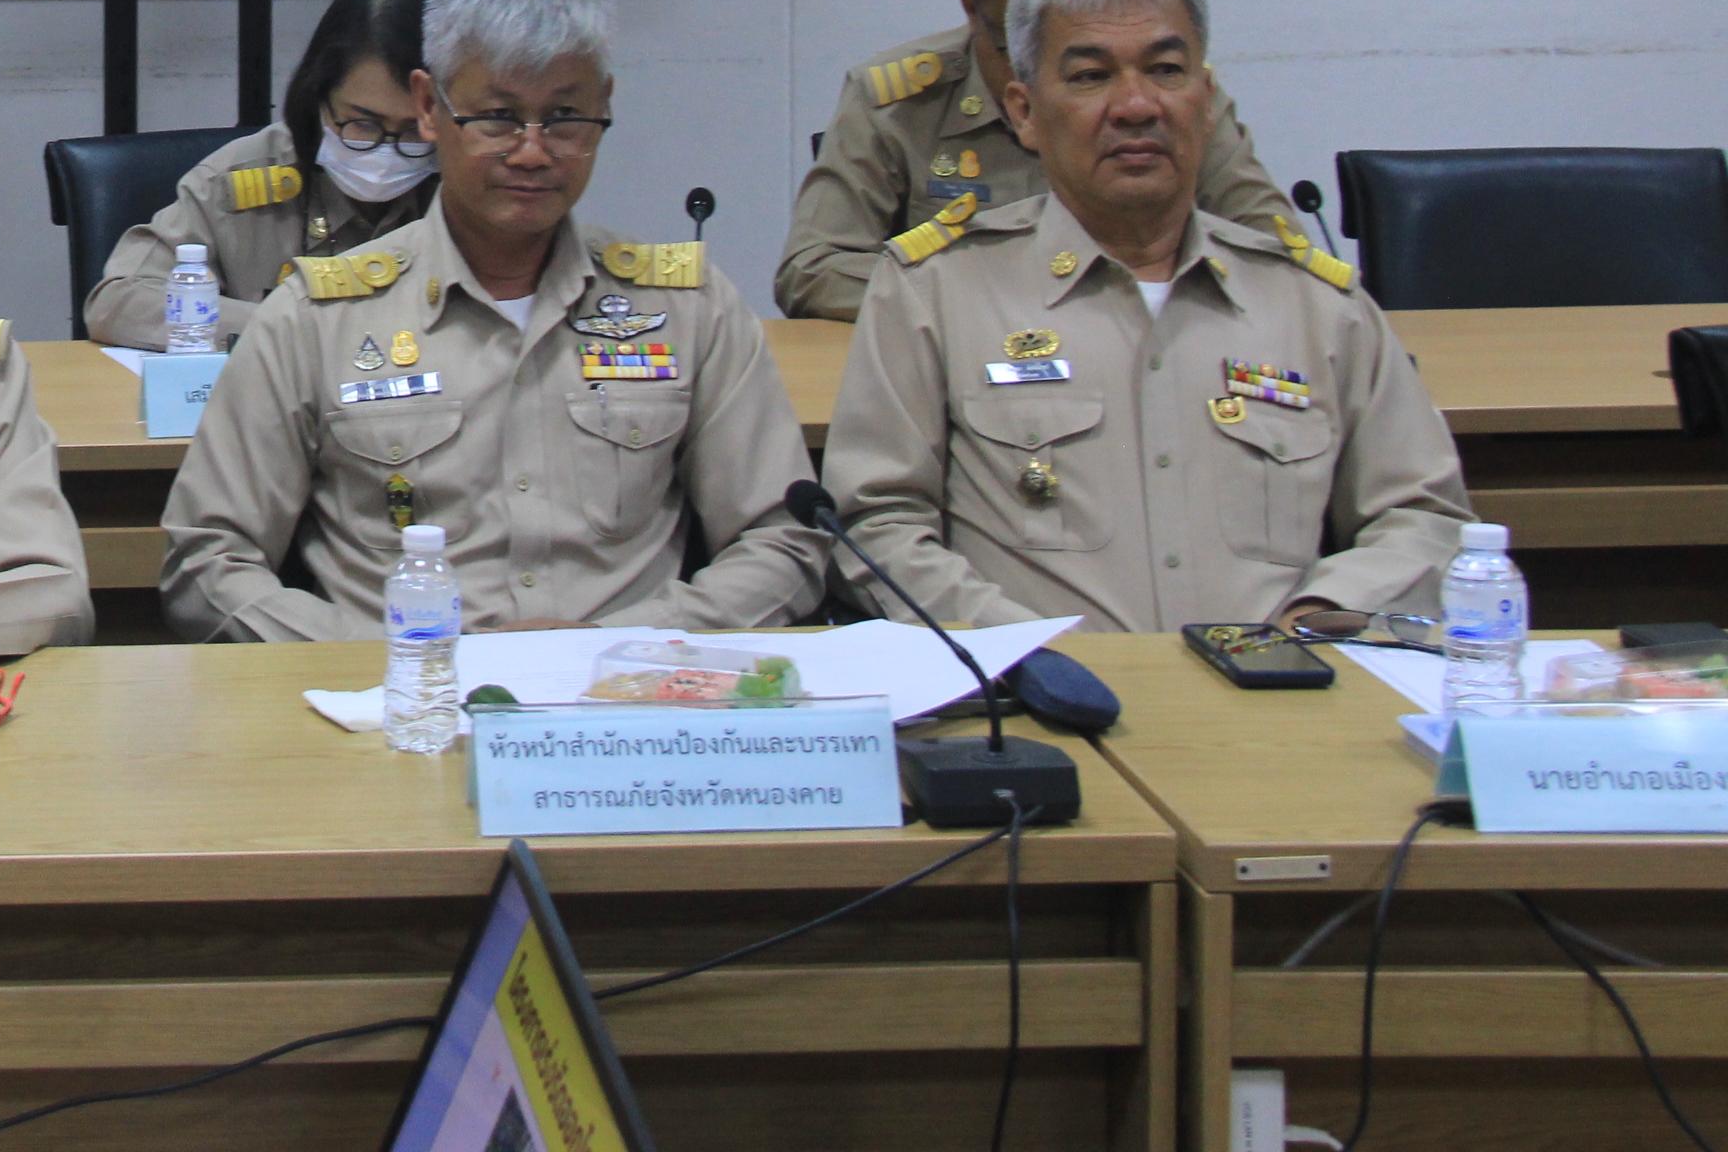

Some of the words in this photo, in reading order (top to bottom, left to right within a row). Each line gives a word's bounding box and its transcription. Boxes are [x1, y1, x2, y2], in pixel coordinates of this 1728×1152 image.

[488, 729, 881, 759] หัวหน้าสำนักงานป้องกันและบรรเทา
[533, 779, 843, 810] สาธารณภัยจังหวัดหนองคาย
